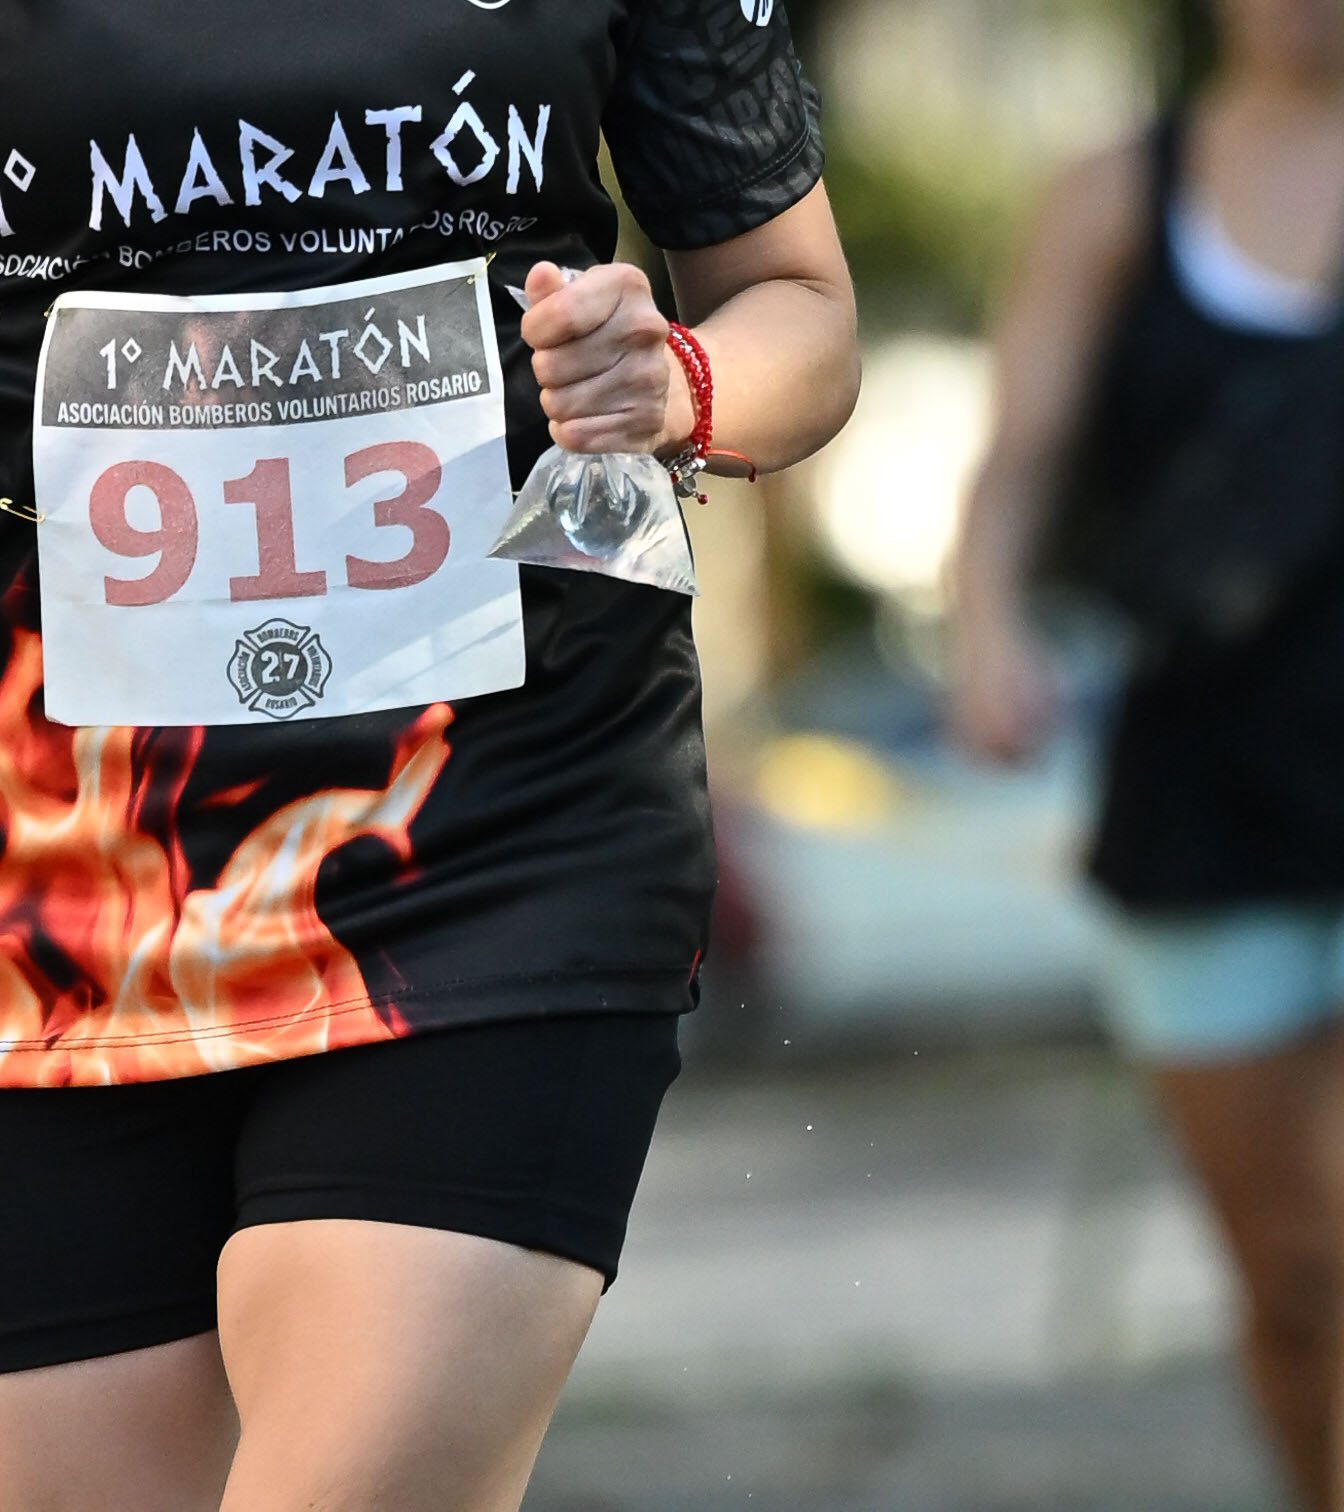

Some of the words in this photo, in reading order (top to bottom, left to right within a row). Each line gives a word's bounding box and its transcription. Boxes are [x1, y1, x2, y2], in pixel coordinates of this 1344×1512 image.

[88, 69, 552, 232] MARATÓN
[162, 306, 431, 392] MARATÓN
[57, 399, 164, 426] ASOCIACIÓN
[169, 400, 273, 426] BOMBEROS
[276, 385, 402, 421] VOLUNTARIOS
[406, 370, 483, 405] ROSARIO
[88, 440, 451, 608] 913
[260, 650, 300, 685] 27
